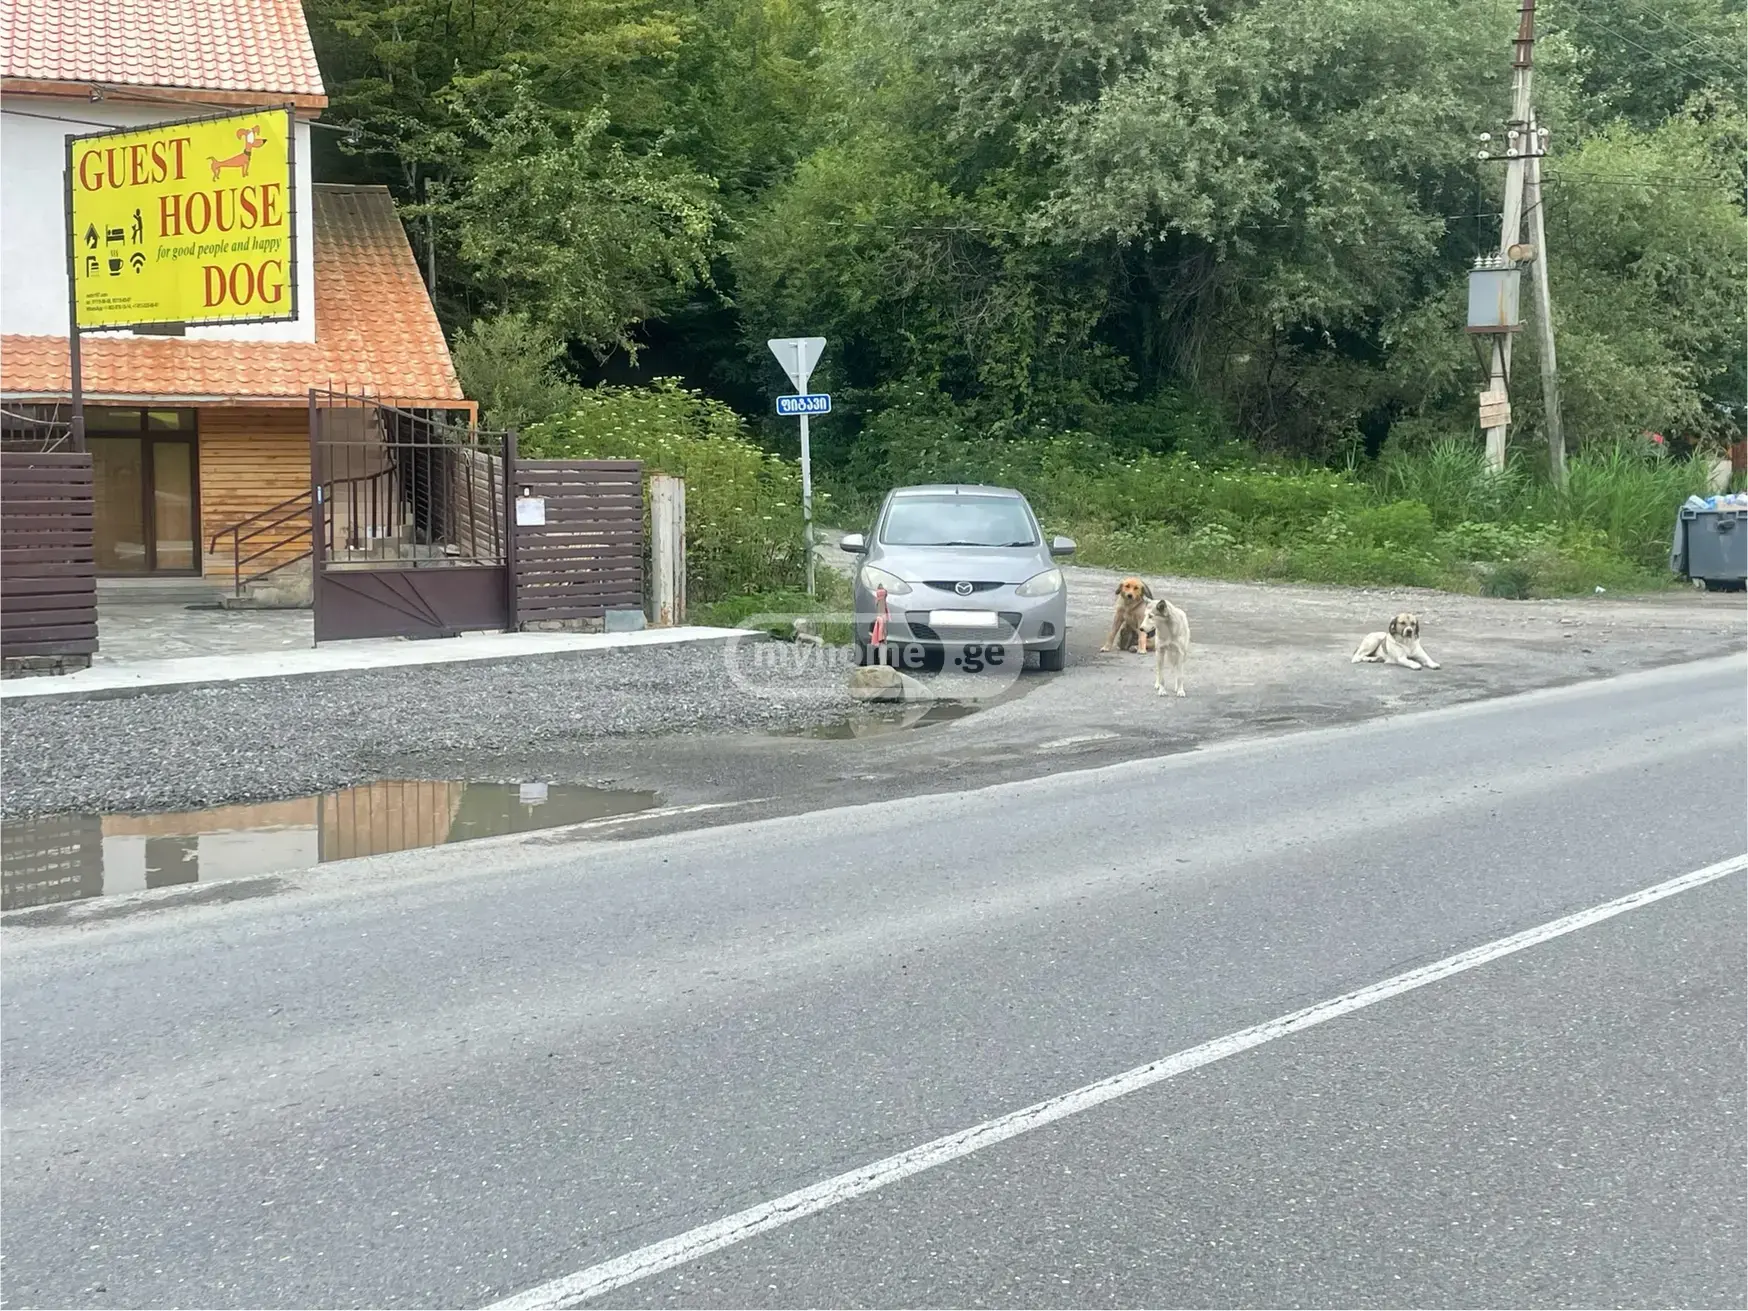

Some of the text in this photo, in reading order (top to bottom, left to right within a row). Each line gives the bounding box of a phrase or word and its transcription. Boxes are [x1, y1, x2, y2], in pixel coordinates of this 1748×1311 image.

[80, 137, 191, 192] GUEST
[158, 183, 283, 237] HOUSE
[156, 236, 282, 262] for good people and happy
[203, 259, 284, 308] DOG
